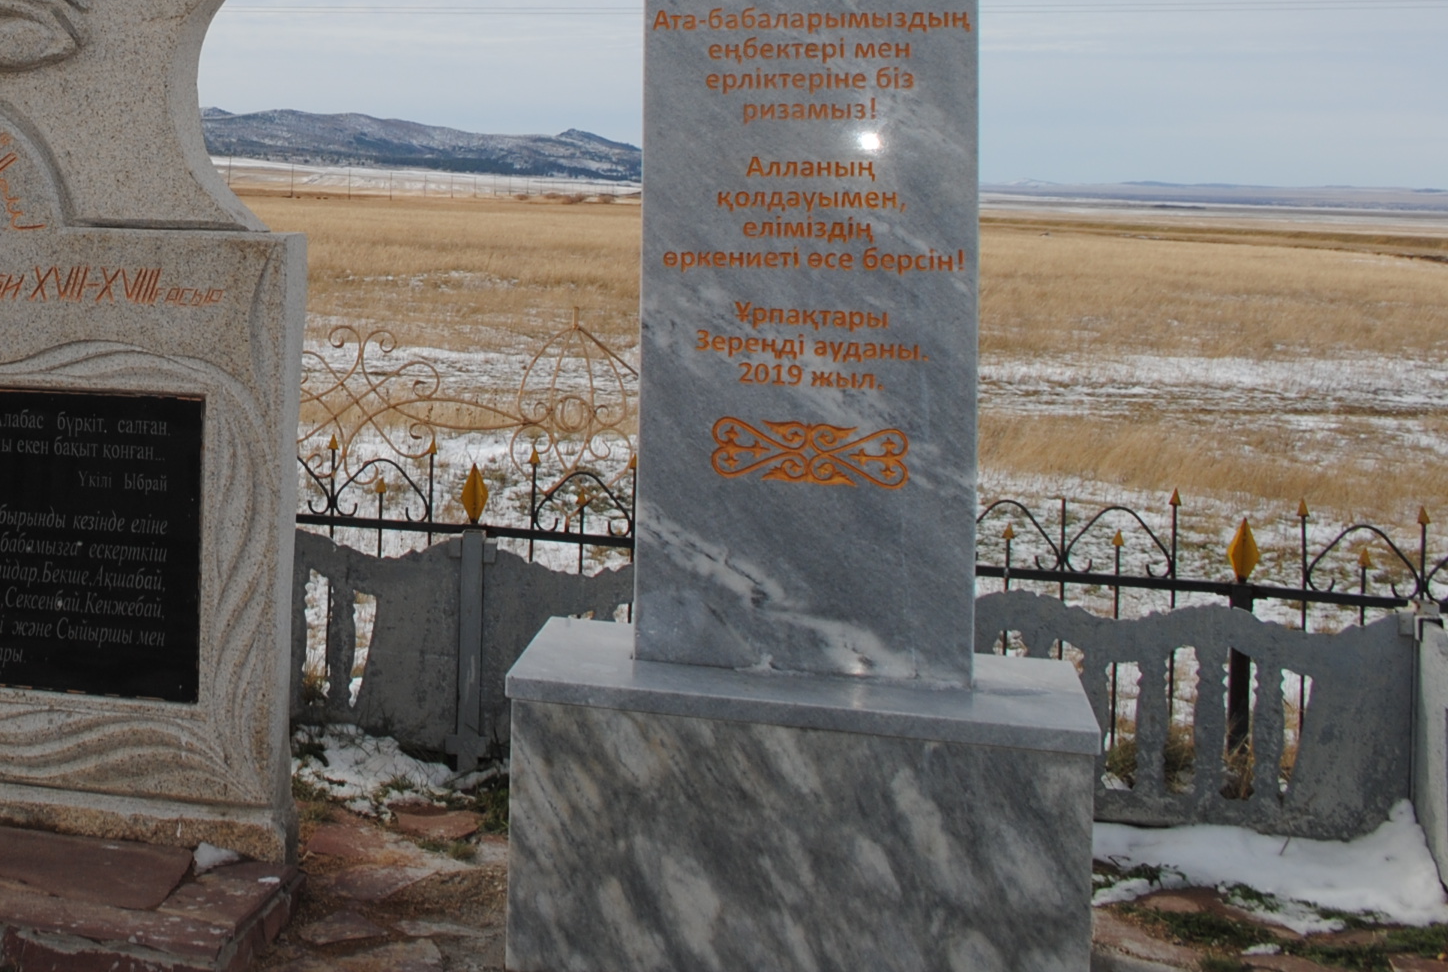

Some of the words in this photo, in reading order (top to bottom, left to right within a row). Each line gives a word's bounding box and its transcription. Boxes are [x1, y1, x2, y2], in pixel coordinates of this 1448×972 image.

[652, 6, 972, 33] Ата-бабаларымыздың
[707, 37, 846, 63] еңбектері
[854, 41, 912, 59] мен
[704, 67, 868, 94] ерліктеріне
[875, 66, 915, 90] біз
[742, 97, 878, 125] ризамыз!
[745, 155, 876, 181] Алланың
[717, 189, 907, 212] қолдауымен,
[742, 215, 874, 242] еліміздің
[662, 245, 800, 272] өркениеті
[807, 249, 854, 269] өсе
[862, 246, 965, 275] берсін!
[734, 300, 889, 332] Ұрпақтары
[695, 329, 805, 360] Зереңді
[813, 339, 929, 363] ауданы.
[738, 362, 803, 386] 2019
[810, 370, 885, 391] жыл.
[17, 437, 49, 455] екен
[53, 435, 99, 459] бақыт
[124, 472, 168, 496] Ыбрай
[73, 510, 125, 533] кезінде
[131, 514, 168, 536] еліне
[89, 541, 168, 566] ескерткіш
[11, 621, 53, 639] және
[56, 616, 133, 648] Сыйыршы
[136, 627, 166, 647] мен
